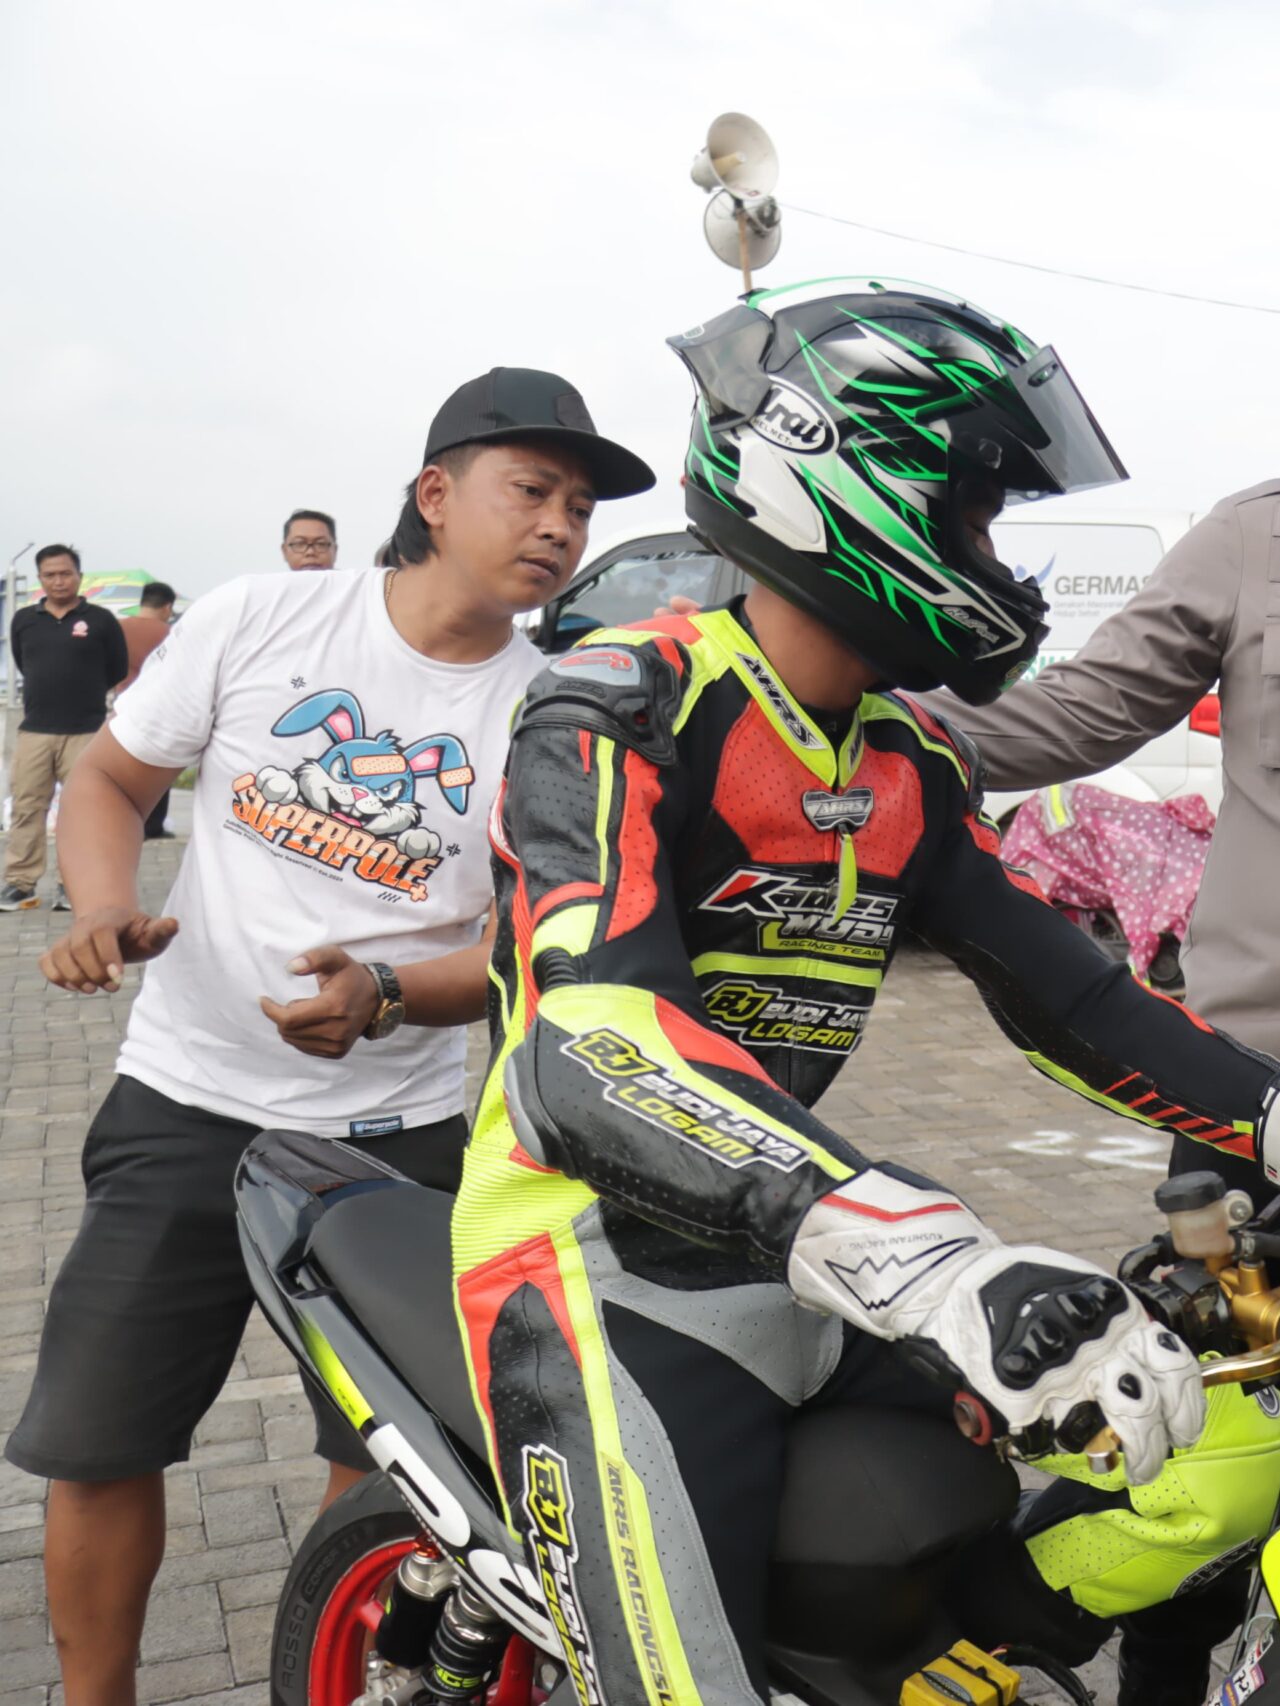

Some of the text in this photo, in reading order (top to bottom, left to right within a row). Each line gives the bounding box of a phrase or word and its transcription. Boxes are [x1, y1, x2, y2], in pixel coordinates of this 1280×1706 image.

[232, 785, 444, 893] SUPERPOLE
[778, 939, 882, 958] RACING TEAM
[750, 1022, 857, 1047] LOGAM
[759, 1003, 826, 1025] BUDI
[617, 1086, 754, 1158] LOGAM
[633, 1073, 722, 1120] BUDI
[715, 1114, 802, 1162] JAYA
[547, 1541, 587, 1645] BUDI
[276, 1606, 308, 1689] ROSSO
